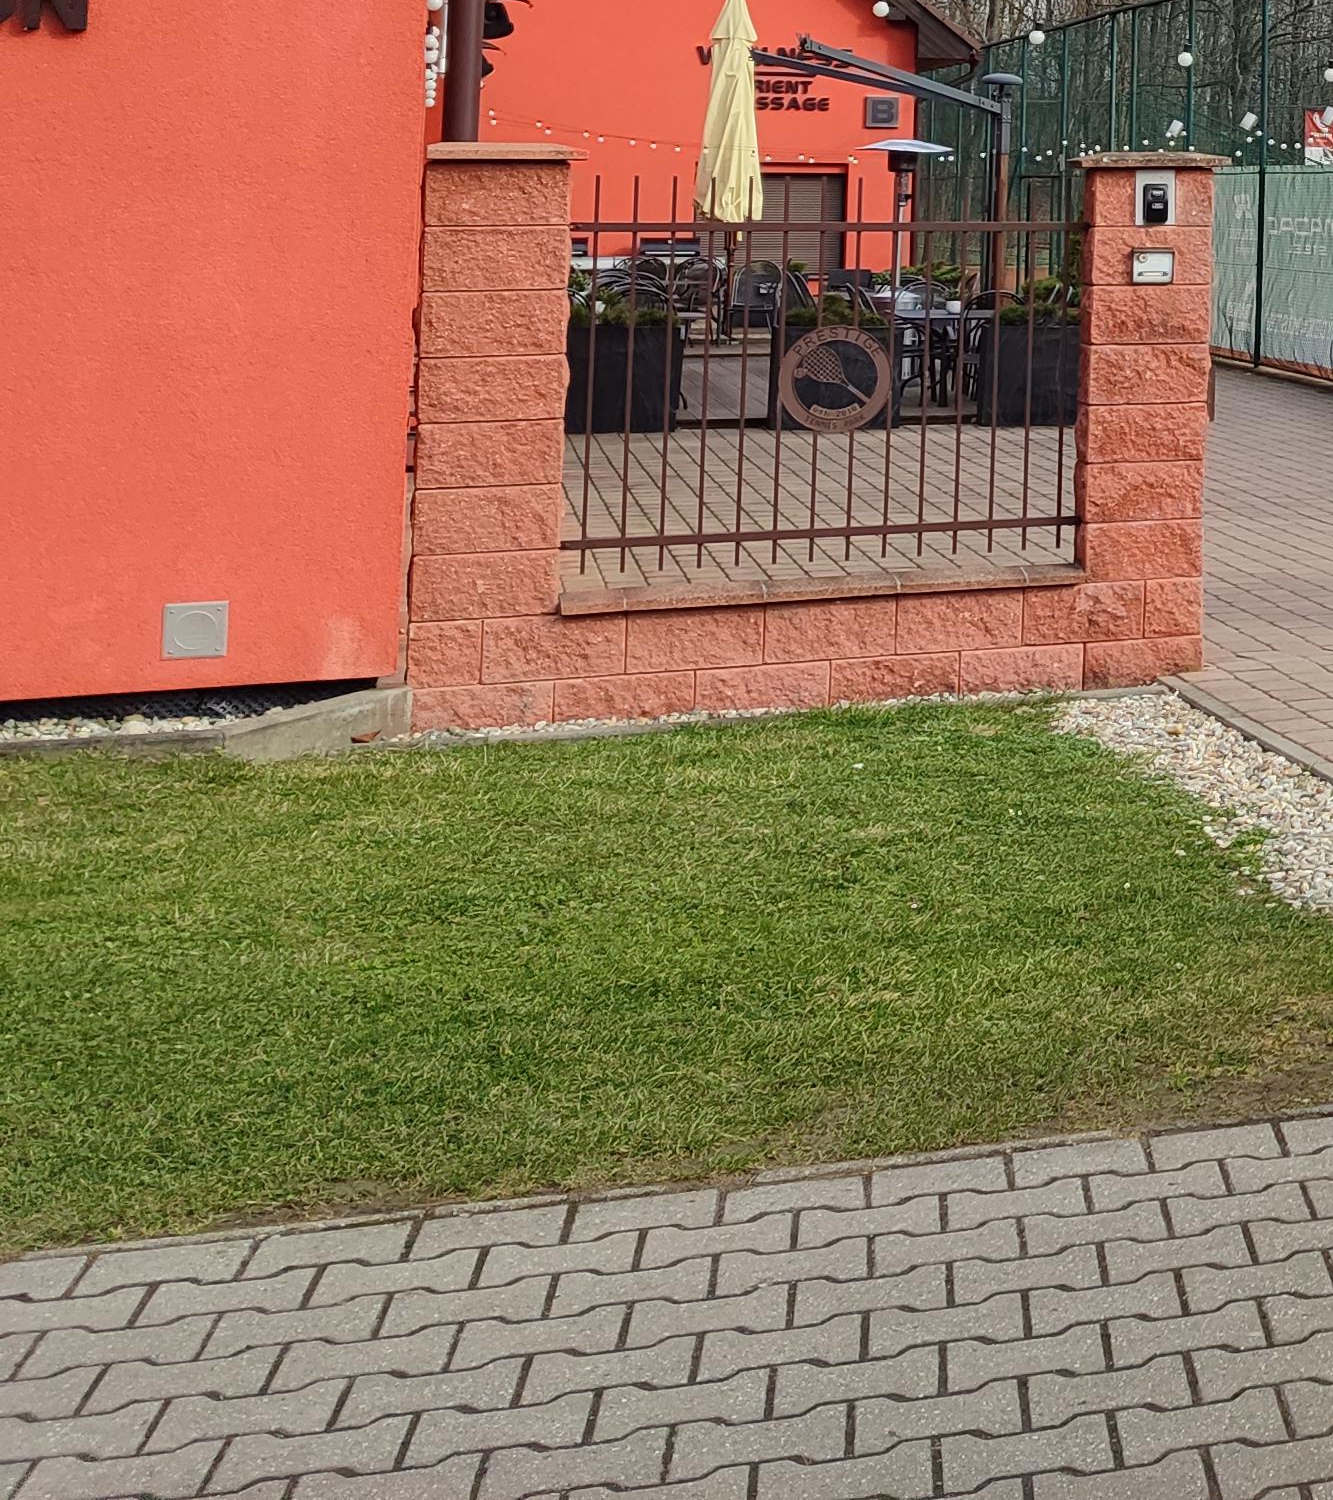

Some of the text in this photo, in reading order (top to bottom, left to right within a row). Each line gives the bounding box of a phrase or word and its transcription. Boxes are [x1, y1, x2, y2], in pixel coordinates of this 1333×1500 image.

[755, 80, 814, 94] RIENT
[756, 97, 830, 112] SSAGE
[873, 100, 895, 124] B
[792, 328, 881, 358] PRESTIGE
